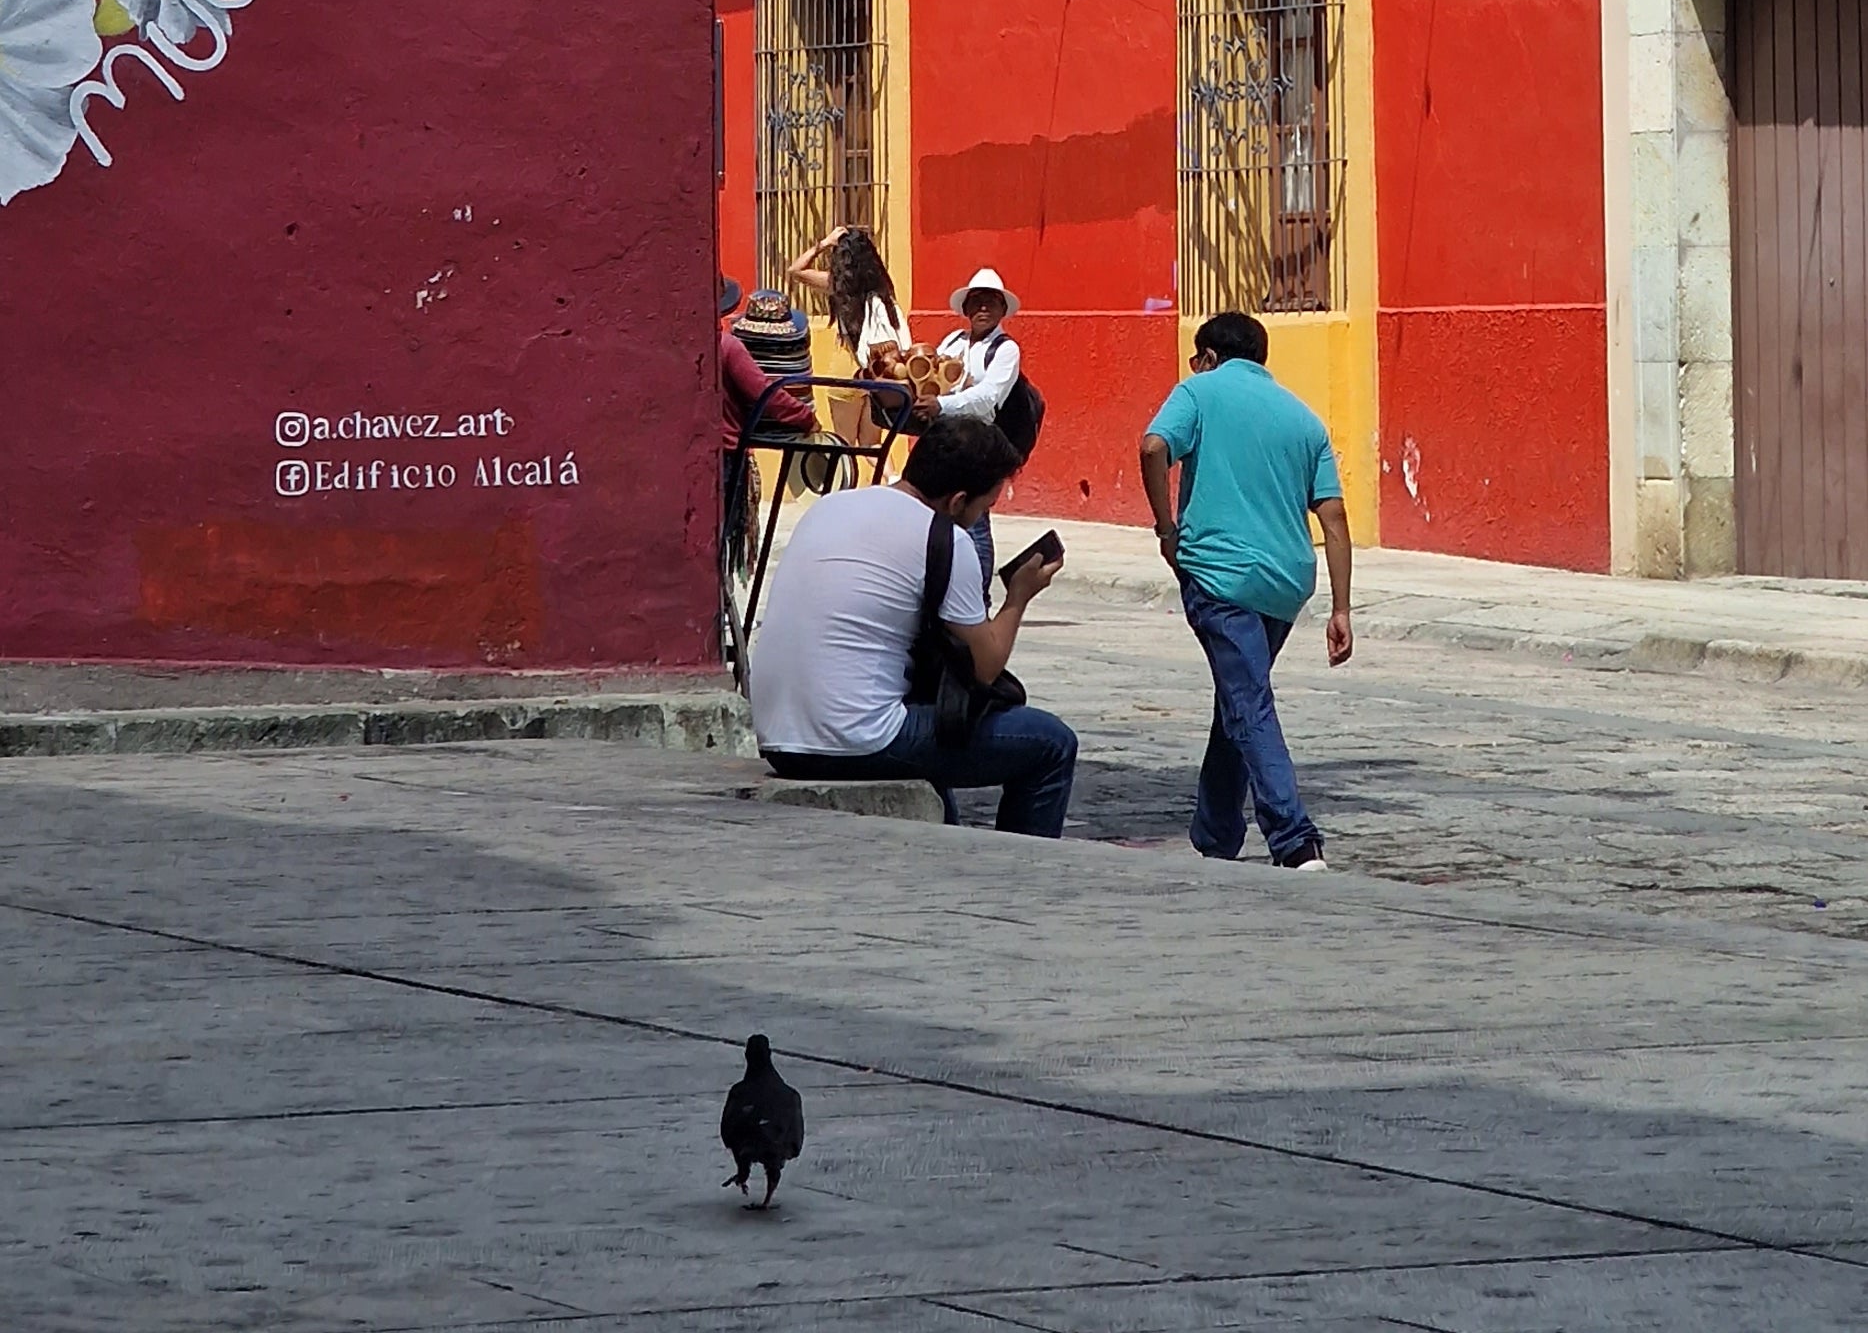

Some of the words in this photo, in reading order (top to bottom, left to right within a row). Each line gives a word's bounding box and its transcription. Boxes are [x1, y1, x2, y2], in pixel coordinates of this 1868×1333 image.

[312, 406, 515, 440] a.chavez_art
[313, 460, 457, 492] Edificio
[473, 450, 580, 487] Alcalá
